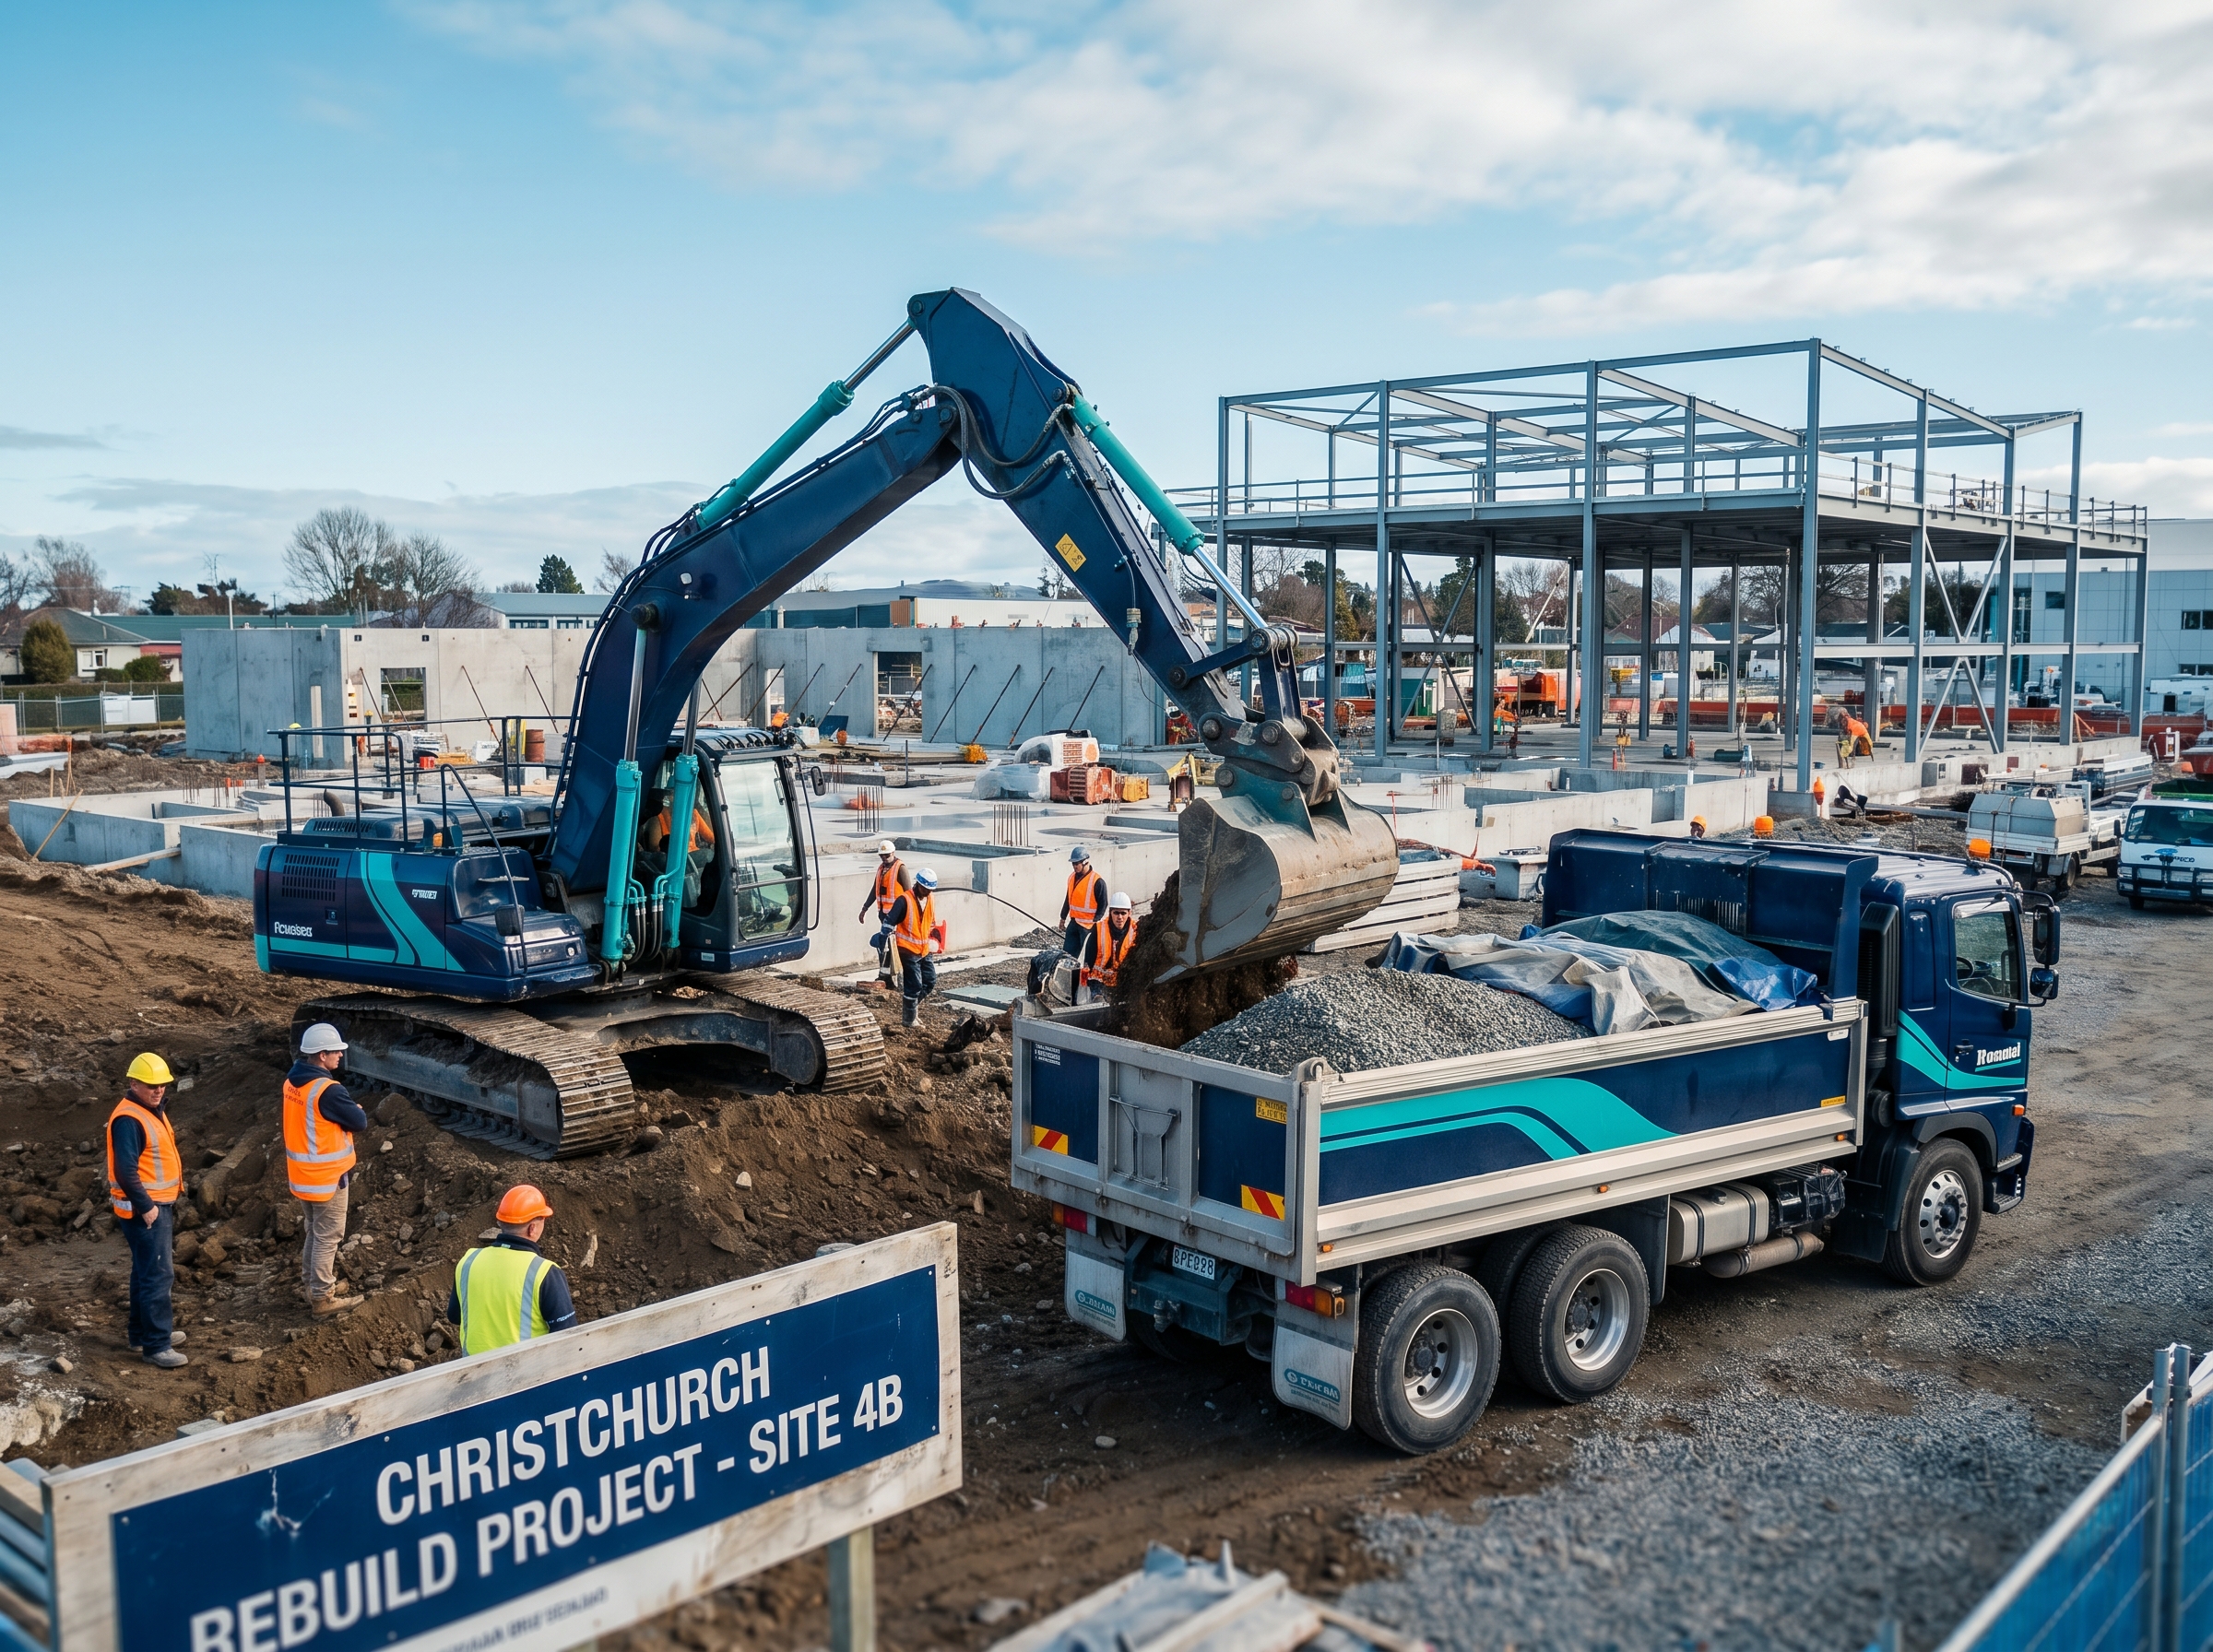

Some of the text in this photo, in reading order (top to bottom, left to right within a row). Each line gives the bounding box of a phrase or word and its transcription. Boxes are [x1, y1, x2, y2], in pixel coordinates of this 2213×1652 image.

[189, 1531, 458, 1652] REBUILD
[477, 1443, 703, 1577] PROJECT
[716, 1456, 736, 1473] -
[748, 1394, 842, 1474] SITE
[853, 1375, 904, 1433] 4B
[376, 1346, 771, 1526] CHRISTCHURCH
